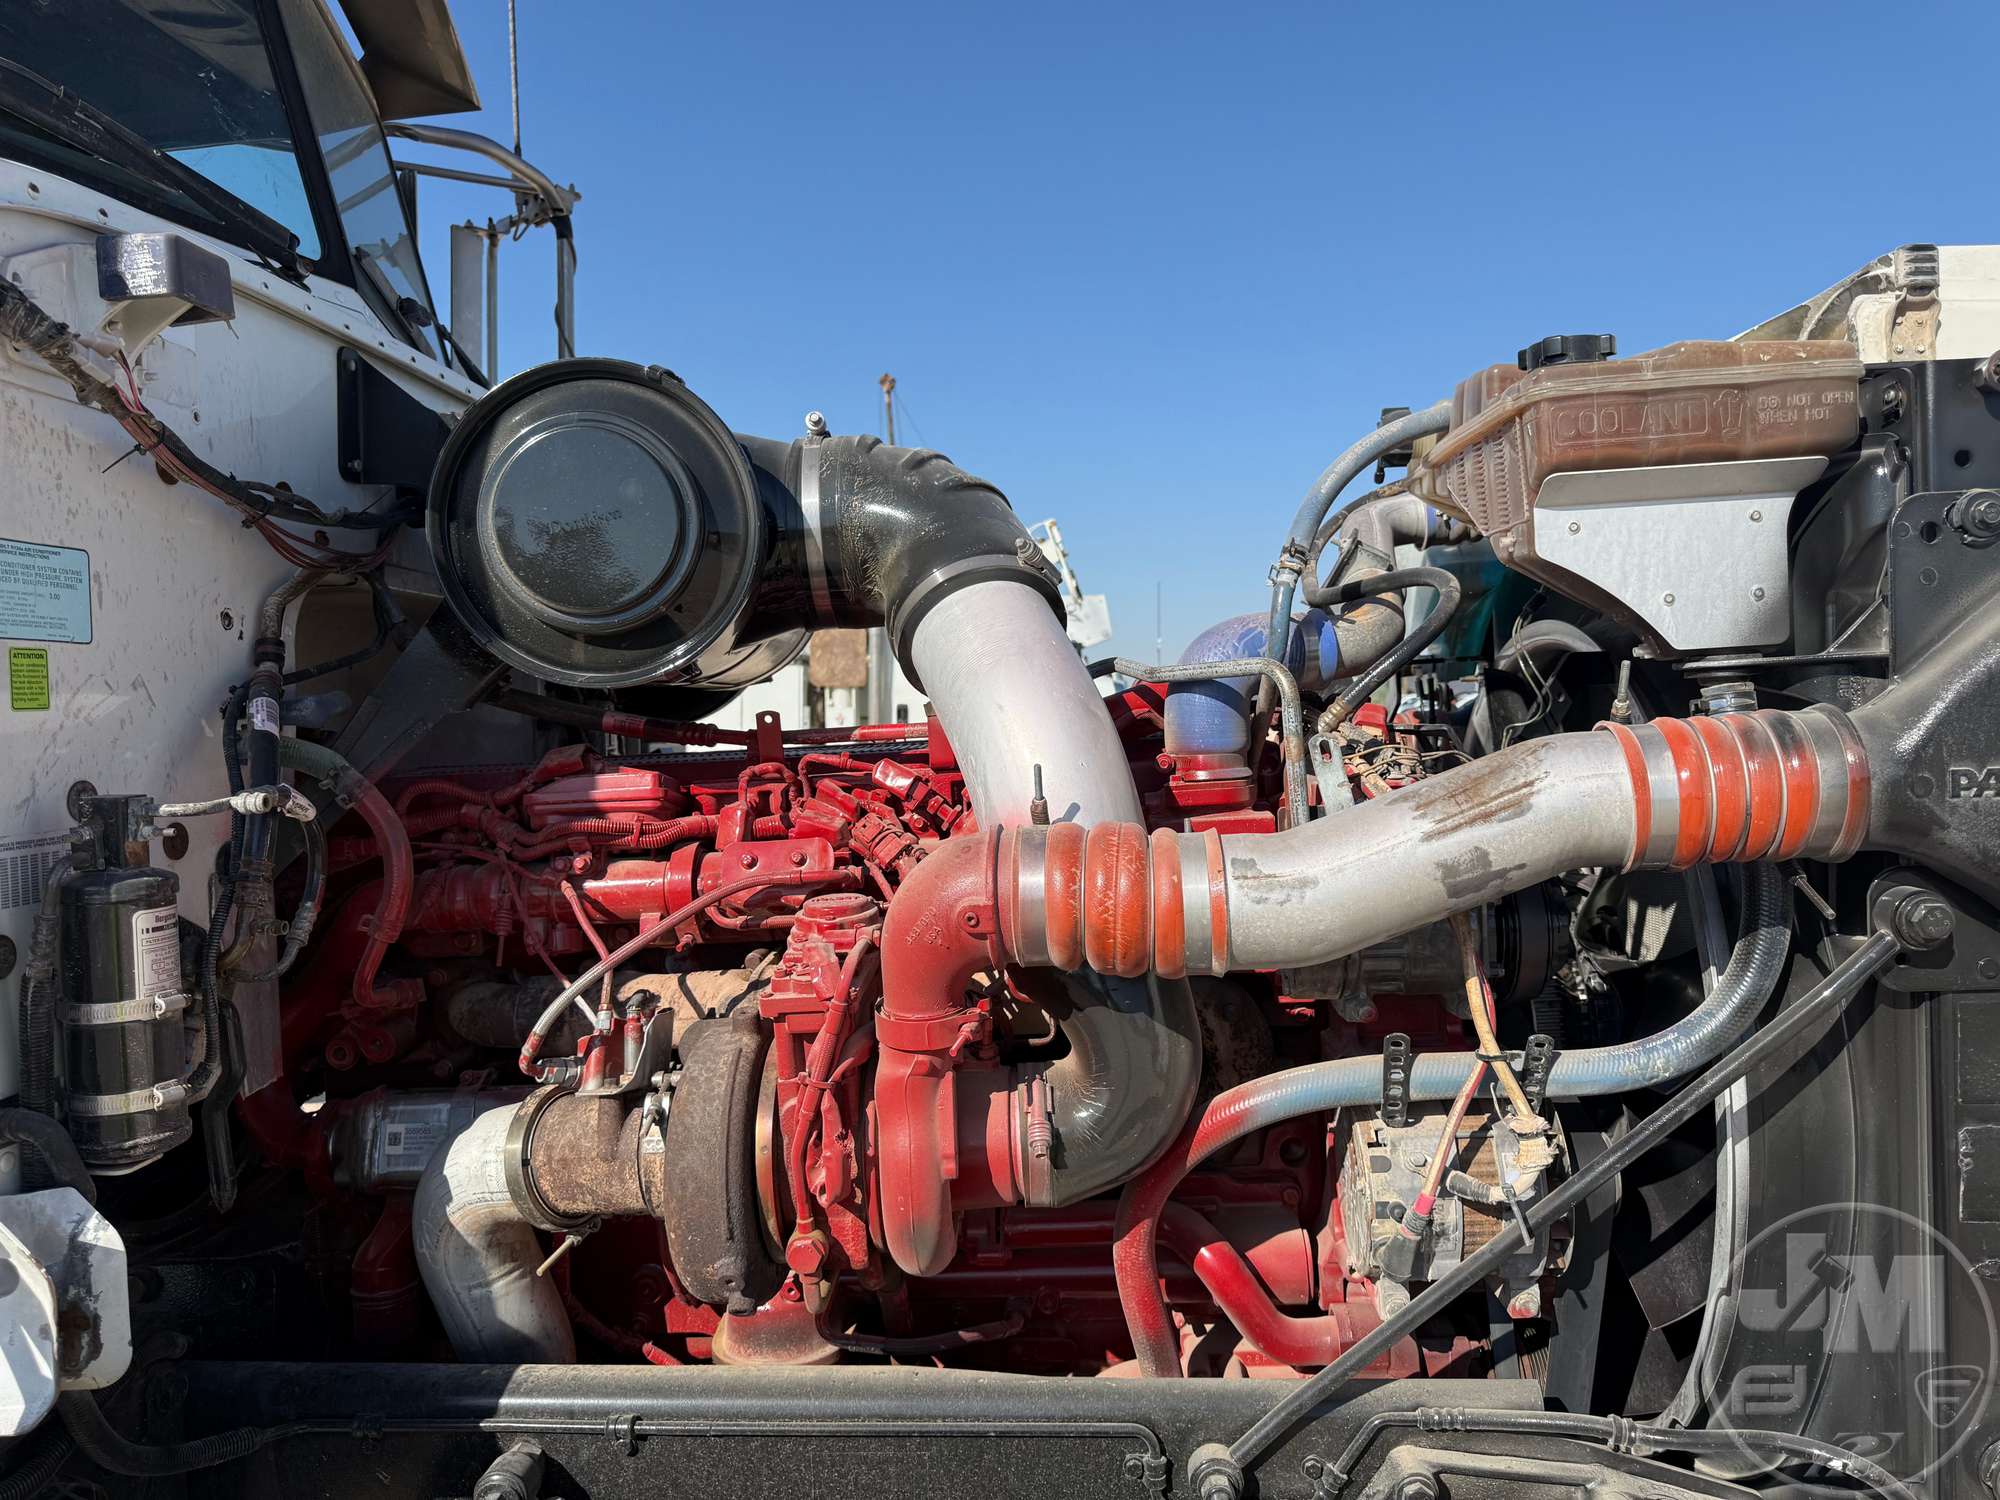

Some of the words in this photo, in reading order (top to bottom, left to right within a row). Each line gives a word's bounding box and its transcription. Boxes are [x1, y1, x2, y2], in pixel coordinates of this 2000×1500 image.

[1759, 396, 1780, 409] DO
[1787, 393, 1811, 406] NOT
[1821, 391, 1854, 405] OPEN
[1555, 402, 1699, 438] COOLANT
[1759, 407, 1798, 424] WHEN
[1804, 407, 1830, 420] HOT
[37, 564, 58, 574] SYSTEM
[13, 652, 44, 660] ATTENTION
